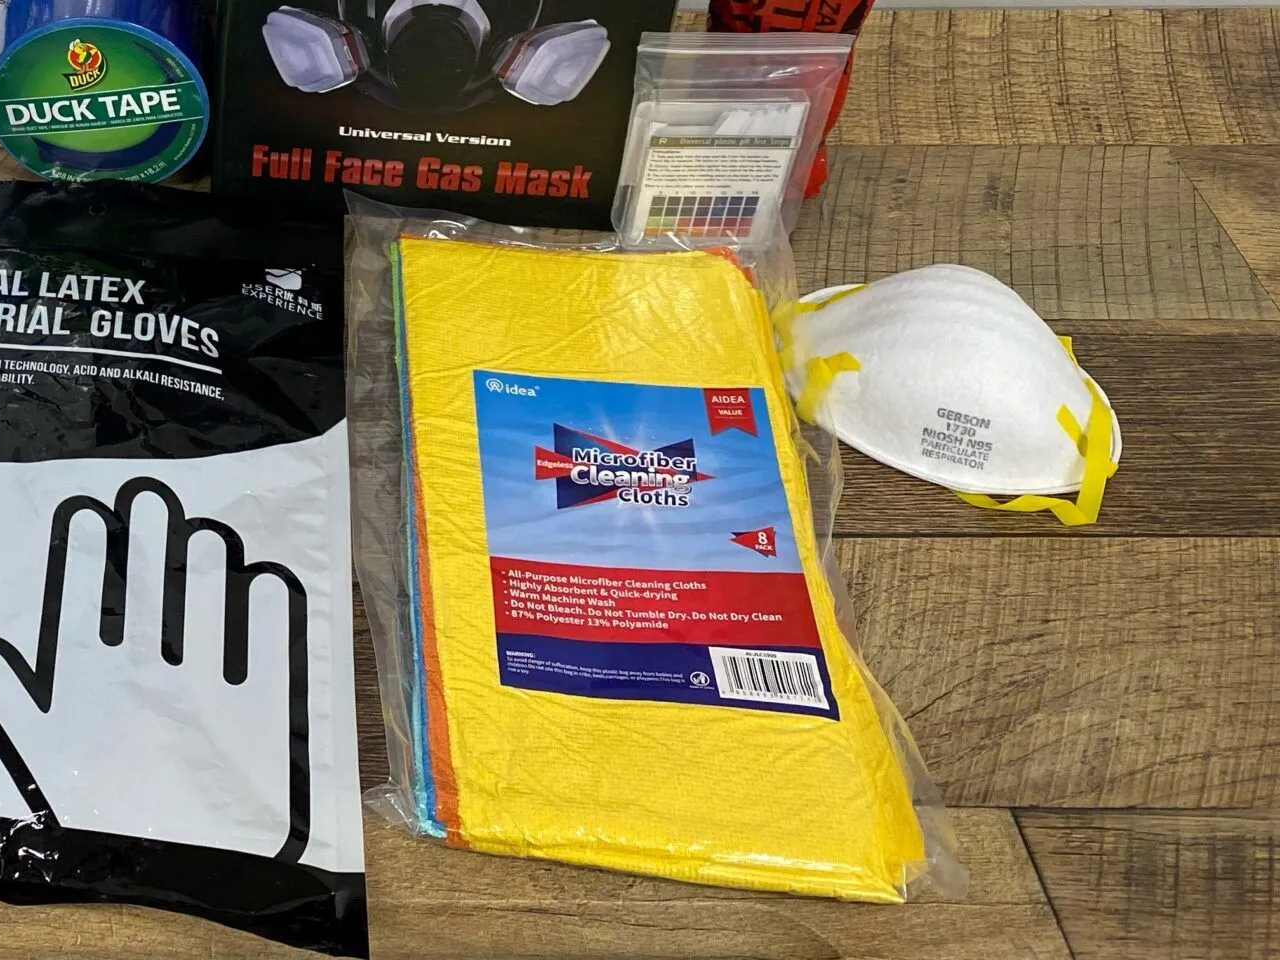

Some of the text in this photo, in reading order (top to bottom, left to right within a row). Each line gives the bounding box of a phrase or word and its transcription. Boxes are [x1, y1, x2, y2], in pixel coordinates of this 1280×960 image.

[70, 69, 101, 88] DUCK
[5, 98, 96, 126] DUCK
[98, 88, 182, 118] TAPE
[338, 125, 512, 147] Universal Version
[251, 144, 593, 199] Full Face Gas Mask
[38, 269, 147, 305] LATEX
[241, 287, 324, 321] EXPERIENCE
[89, 307, 221, 359] GLOVES
[3, 359, 71, 376] TECHNOLOGY,
[72, 363, 98, 376] ACID
[99, 364, 121, 378] AND
[122, 366, 160, 384] ALKALI
[710, 394, 746, 405] AIDEA
[717, 408, 743, 417] VALUE
[936, 407, 992, 430] GERSON
[920, 437, 990, 461] PARTICULATE
[922, 427, 994, 452] NIOSH N95
[536, 458, 574, 470] Edgeless
[573, 447, 698, 472] Microfiber
[921, 447, 985, 471] RESPIRATOR
[570, 464, 692, 494] Cleaning
[618, 487, 690, 507] Cloths
[757, 531, 768, 545] 8
[508, 569, 707, 591] All-Purpose Microfiber Cleaning Cloths
[509, 579, 678, 601] Highly Absorbent & Quick-drying
[509, 589, 616, 608] Warm Machine Wash
[510, 599, 523, 608] Do
[525, 600, 546, 611] Not
[604, 609, 623, 619] Not
[625, 610, 666, 620] Tumble
[708, 612, 728, 621] Not
[730, 612, 750, 624] Dry
[751, 613, 783, 622] Clean
[511, 609, 669, 630] 87% Polyester 13% Polyamide
